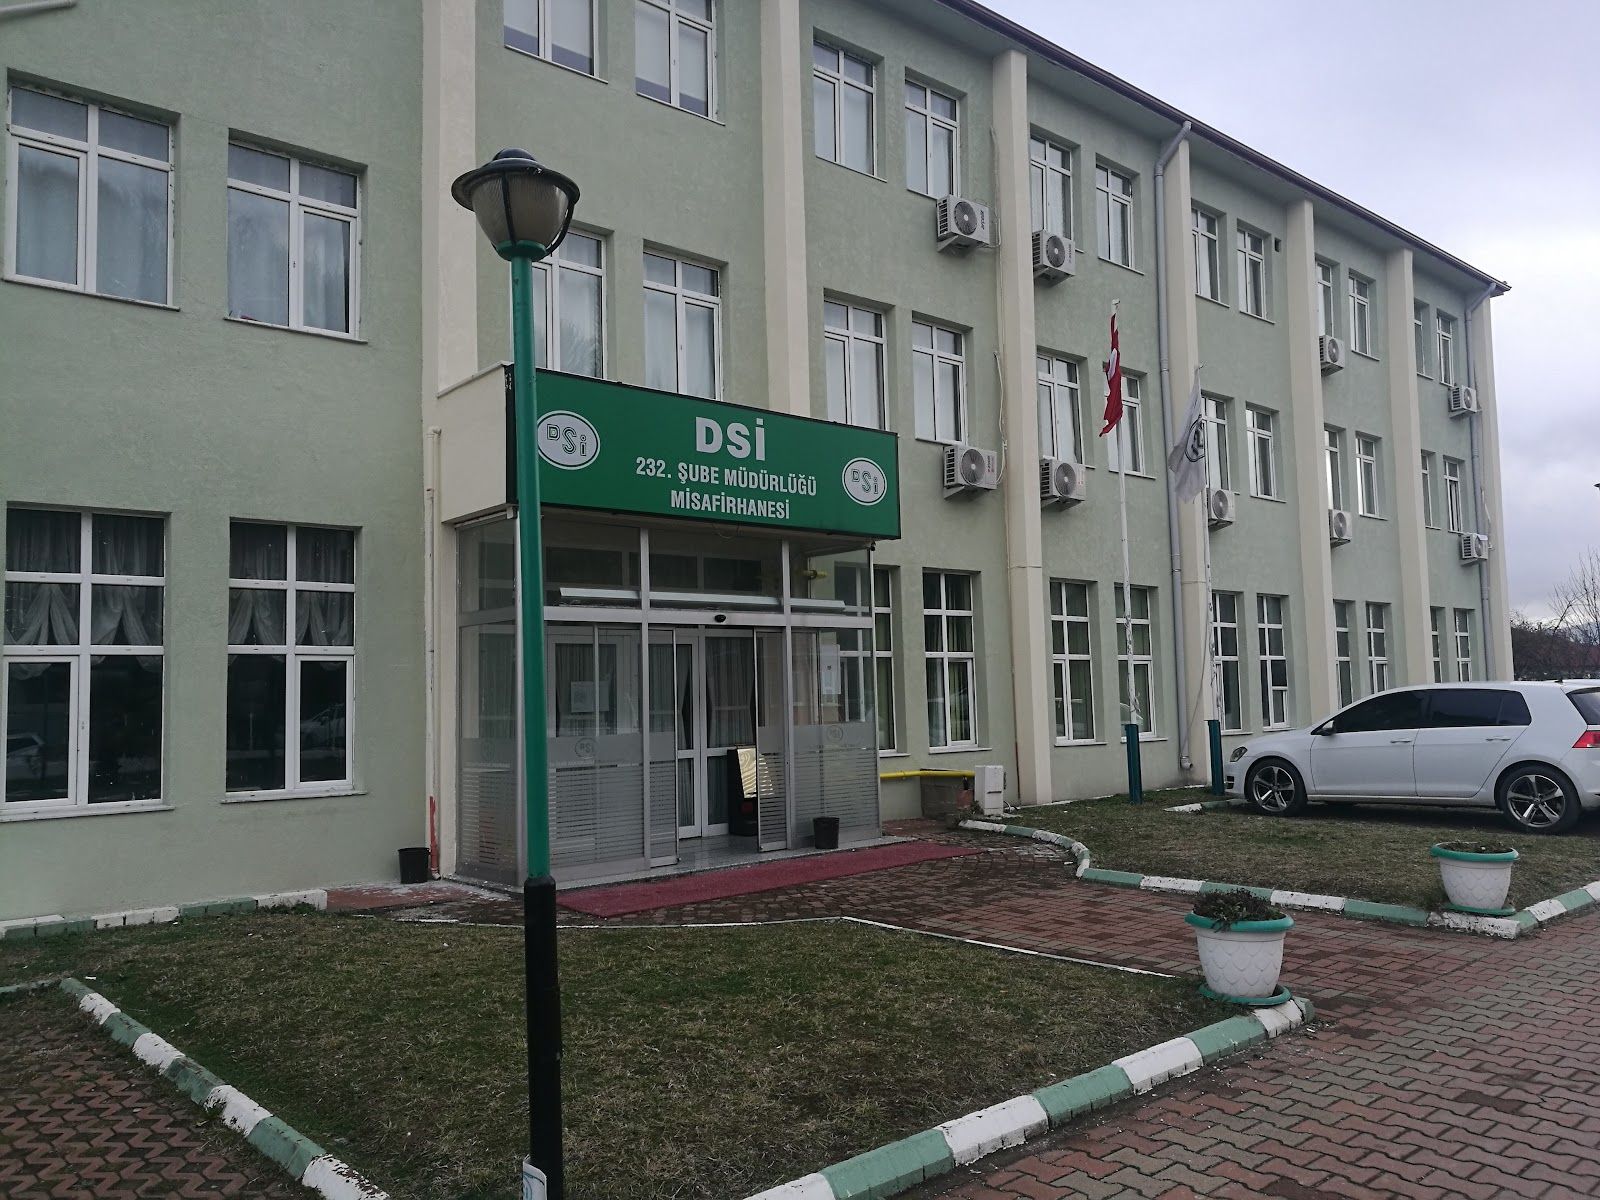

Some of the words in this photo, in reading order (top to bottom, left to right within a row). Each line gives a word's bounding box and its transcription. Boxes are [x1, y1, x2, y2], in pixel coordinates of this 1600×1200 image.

[696, 416, 766, 461] DSİ
[636, 456, 672, 479] 232.
[677, 462, 719, 484] ŞUBE
[724, 466, 817, 496] MÜDÜRLÜĞÜ
[670, 488, 790, 519] MİSAFİRHANESİ
